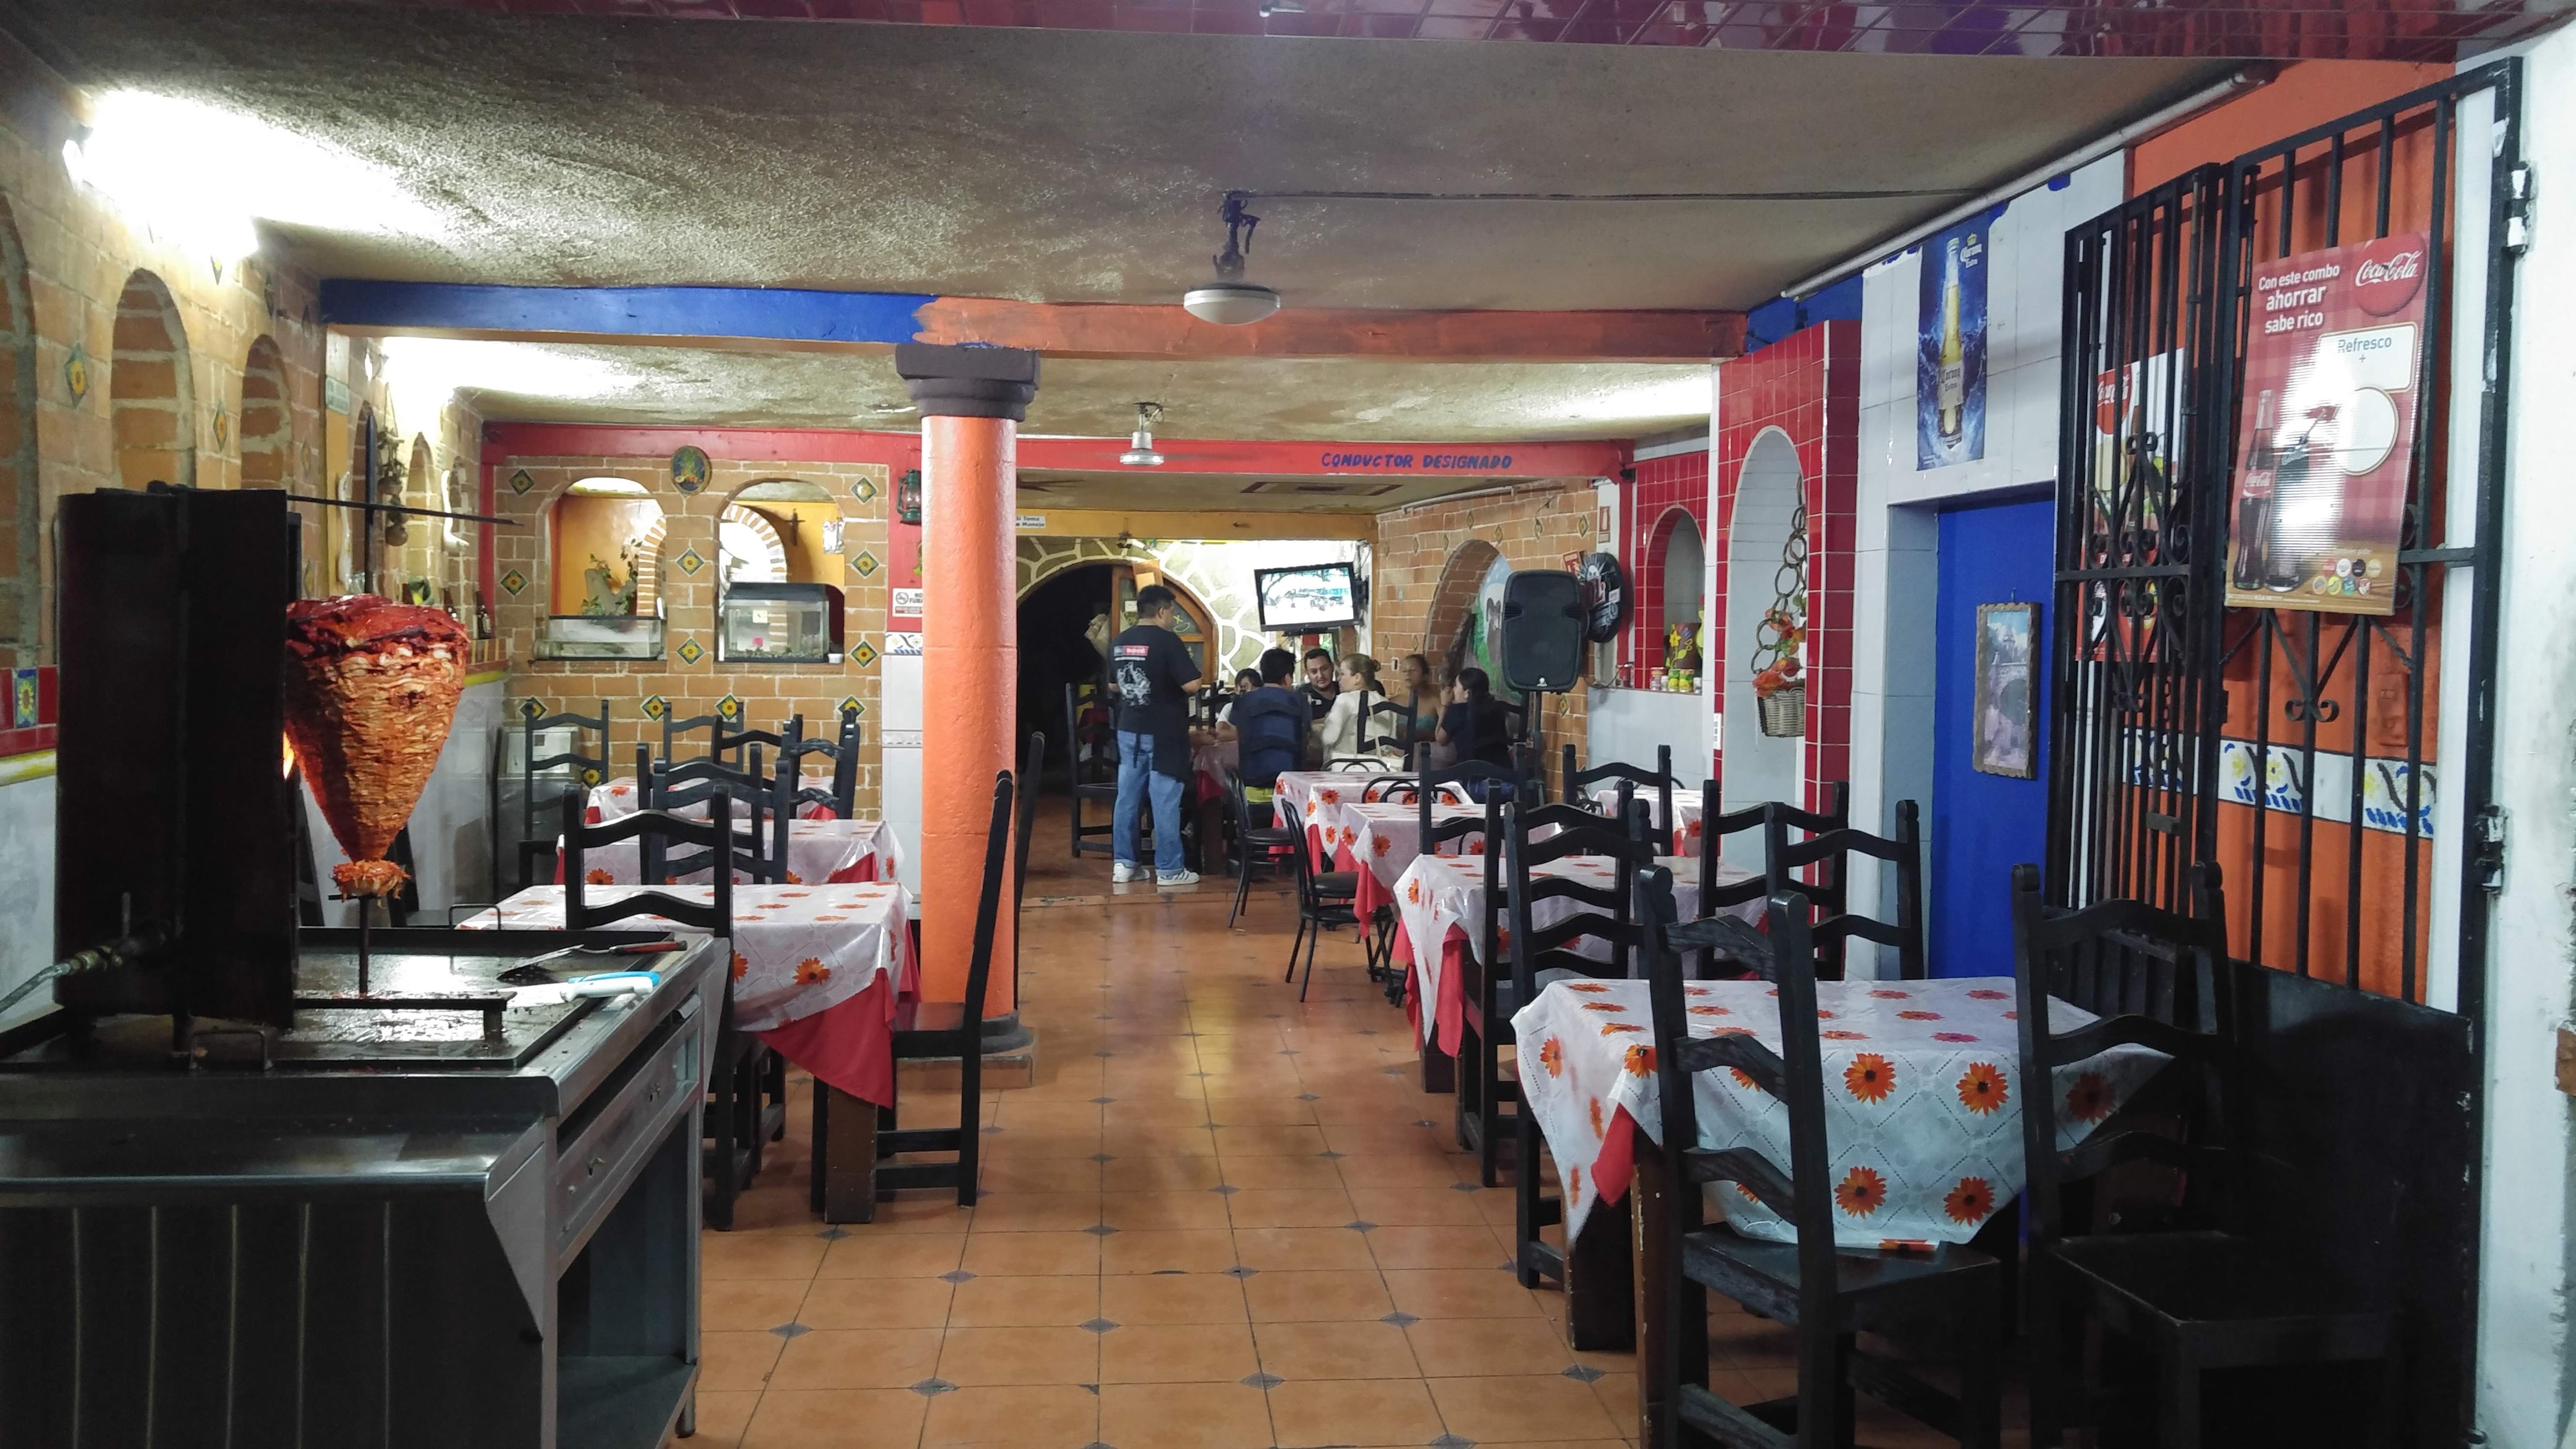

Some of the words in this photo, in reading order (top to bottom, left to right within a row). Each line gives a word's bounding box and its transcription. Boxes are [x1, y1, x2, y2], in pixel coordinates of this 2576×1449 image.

[2259, 276, 2277, 290] Con
[2279, 271, 2301, 287] este
[2302, 263, 2340, 282] combo
[2266, 286, 2327, 311] ahorrar
[2265, 314, 2295, 333] sabe
[2297, 310, 2323, 328] rico
[2338, 337, 2392, 353] Refresco
[1322, 452, 1413, 468] CONDUCTOR
[1423, 455, 1513, 469] DESIGNADO
